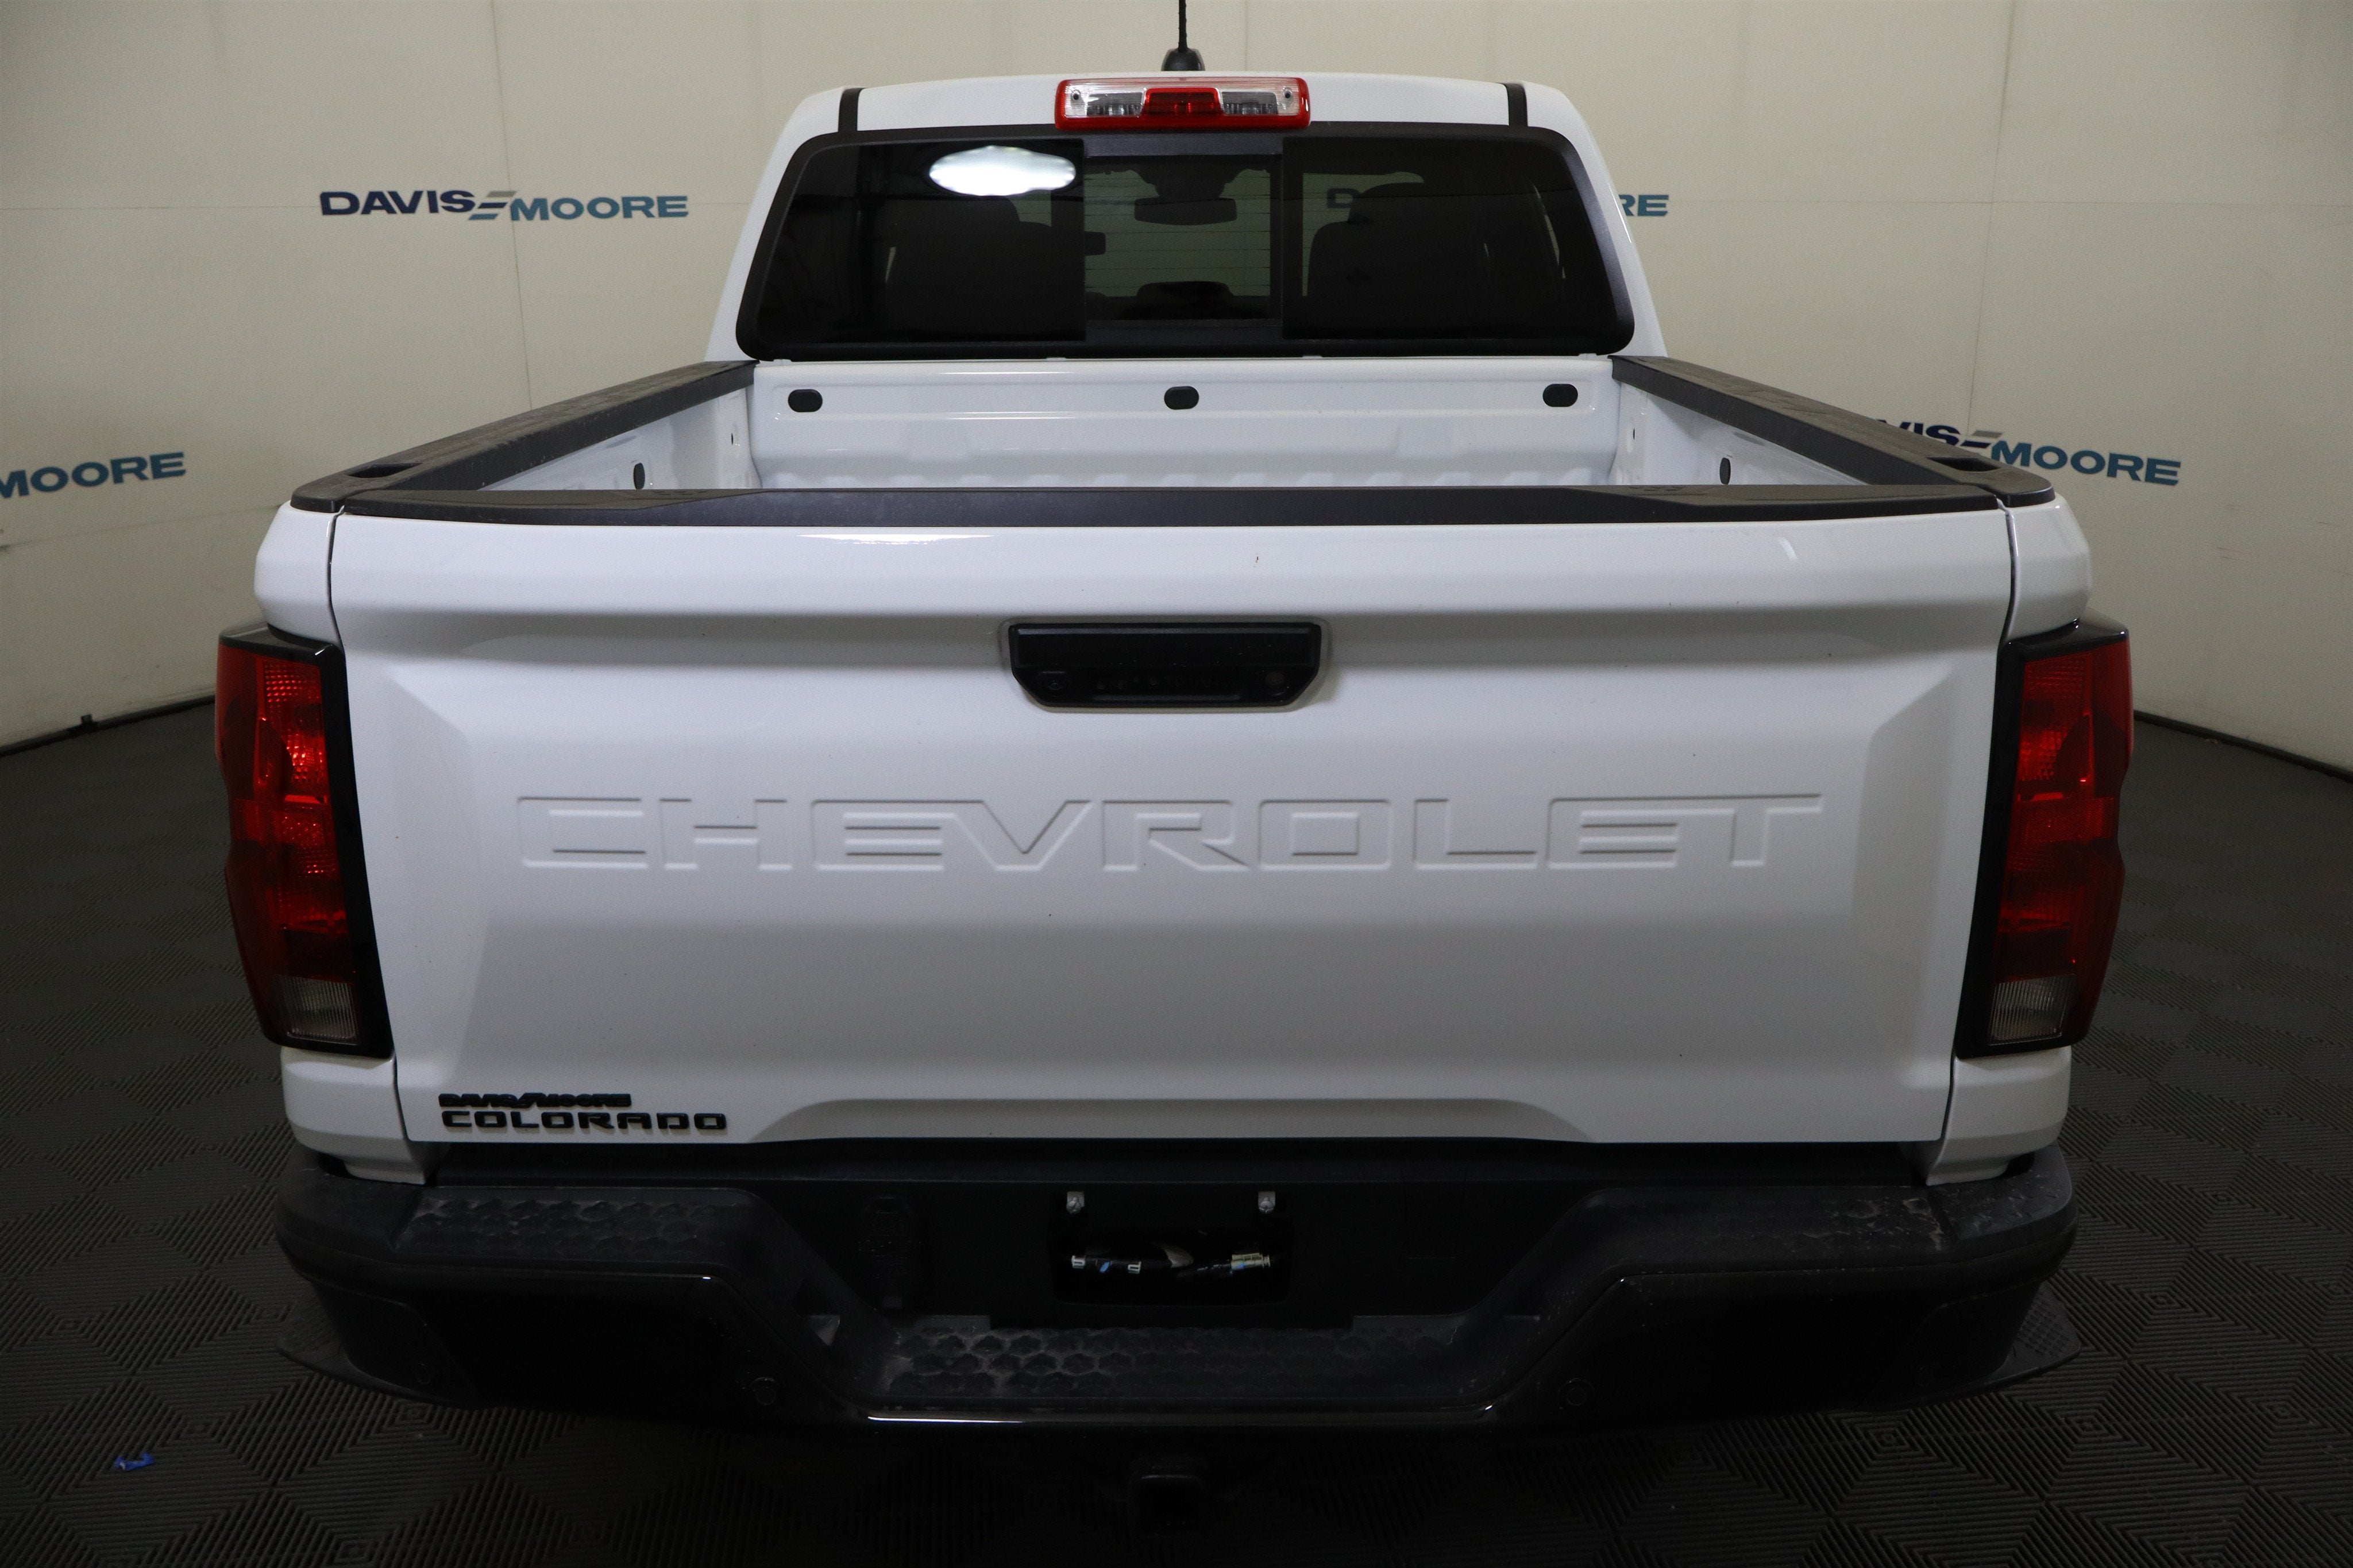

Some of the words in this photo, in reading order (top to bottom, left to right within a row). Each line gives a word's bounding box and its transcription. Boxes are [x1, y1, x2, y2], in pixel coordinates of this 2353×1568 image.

[320, 190, 475, 215] DAVIS
[509, 195, 689, 221] MOORE
[1991, 441, 2181, 486] MOORE
[516, 794, 1823, 871] CHEVROLET
[441, 1110, 727, 1130] COLORADO
